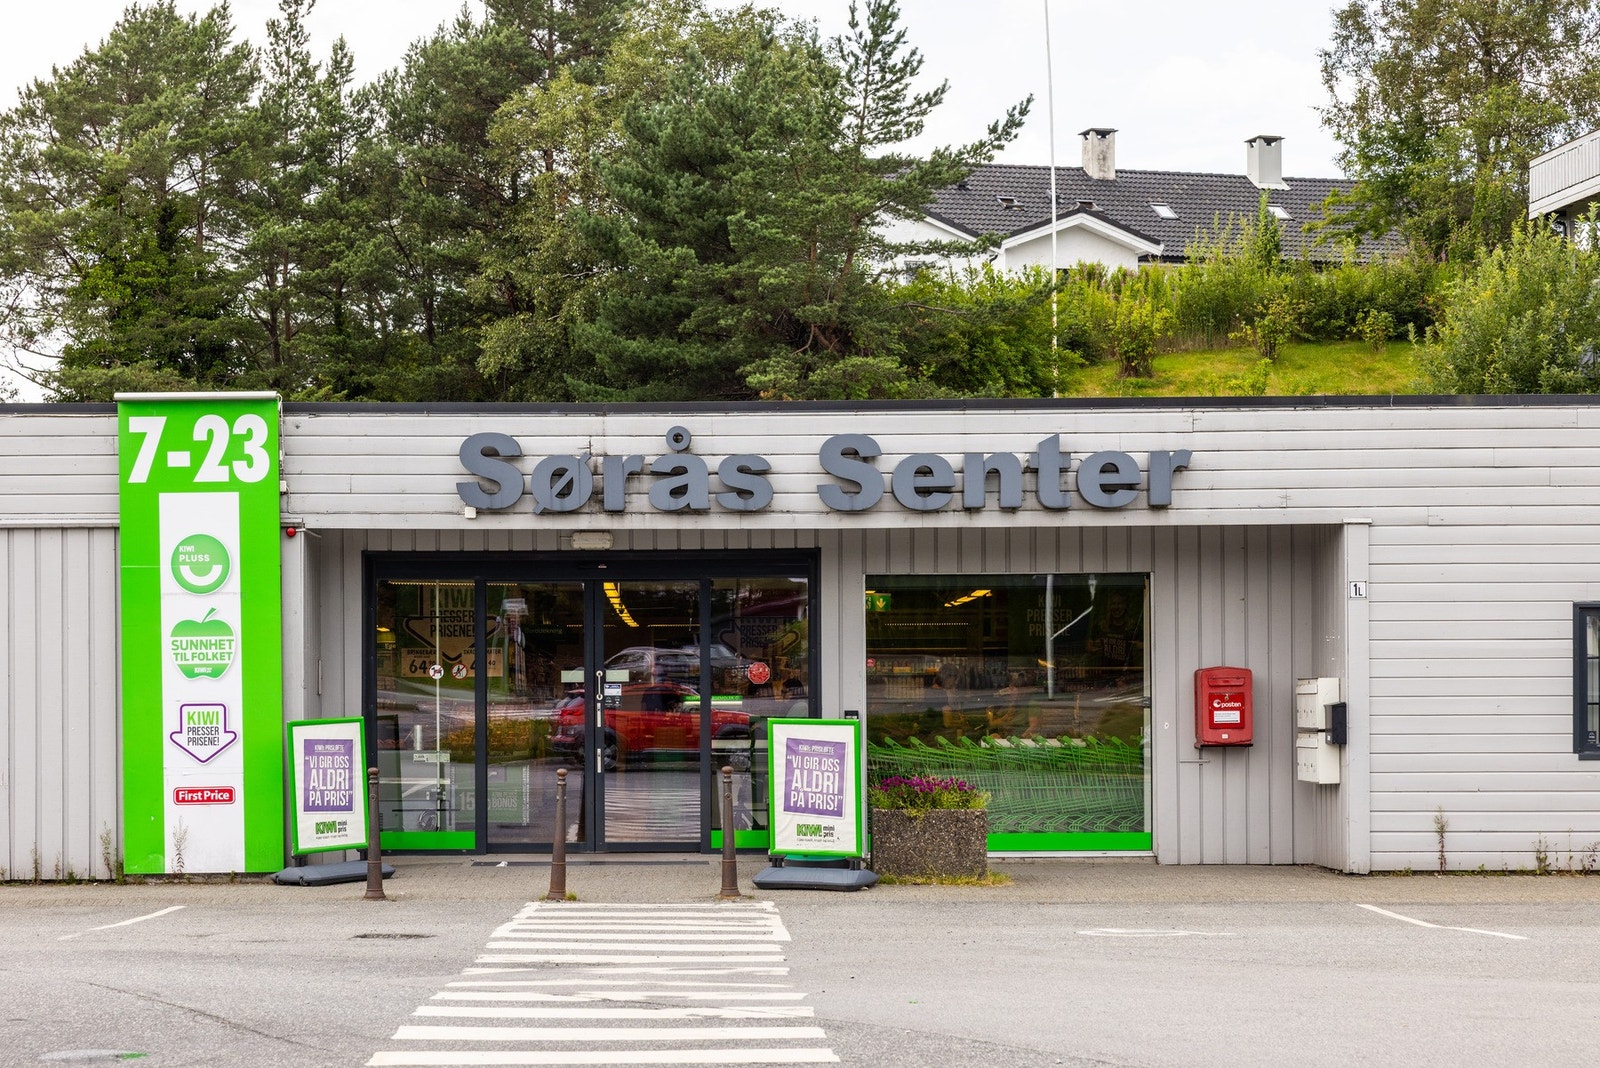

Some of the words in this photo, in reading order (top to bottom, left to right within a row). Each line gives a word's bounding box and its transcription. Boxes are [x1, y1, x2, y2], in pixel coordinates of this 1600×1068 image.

[128, 414, 270, 483] 7-23
[456, 425, 774, 515] Sørås
[817, 433, 1193, 511] Senter
[179, 554, 210, 562] PLUSS
[1026, 608, 1072, 622] PRESER
[171, 639, 234, 651] SUNNHET
[173, 652, 189, 661] TIL
[191, 652, 233, 661] FOLKET
[187, 711, 219, 725] KIWI
[187, 726, 219, 736] PRESSER
[187, 737, 219, 746] PRISENE!
[319, 756, 333, 768] GIR
[334, 756, 349, 768] OSS
[804, 756, 819, 770] GIR
[821, 758, 840, 772] OSS
[310, 769, 348, 790] ALDRI
[792, 769, 838, 794] ALDRI
[178, 791, 202, 800] First
[203, 790, 230, 800] Price
[309, 787, 322, 806] PÅ
[790, 787, 805, 808] PÅ
[315, 820, 337, 834] KIWI
[796, 824, 822, 836] KIWI
